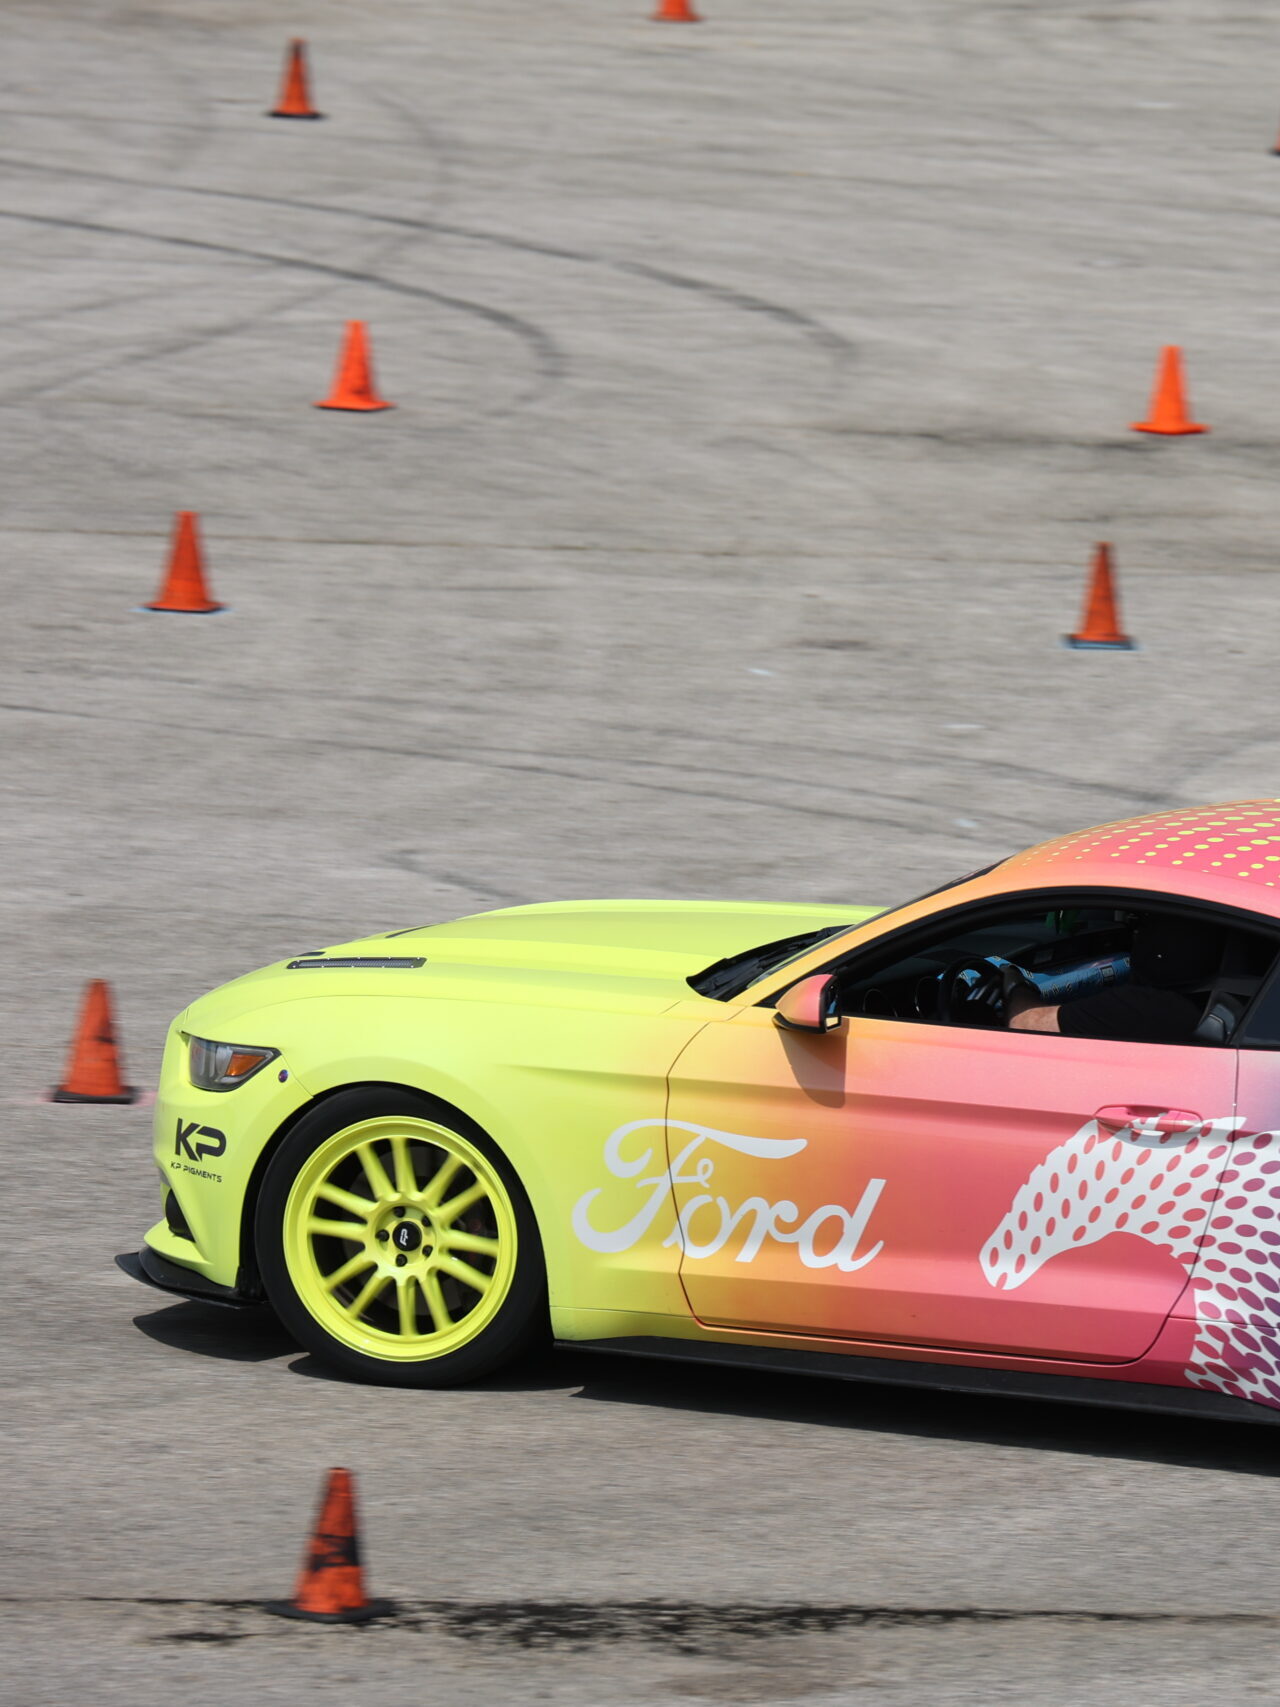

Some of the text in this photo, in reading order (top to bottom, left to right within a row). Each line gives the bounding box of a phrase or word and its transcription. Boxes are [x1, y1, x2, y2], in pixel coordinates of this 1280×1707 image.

[174, 1117, 227, 1162] KP
[170, 1161, 223, 1183] KP PIGMENTS
[571, 1118, 887, 1273] Ford
